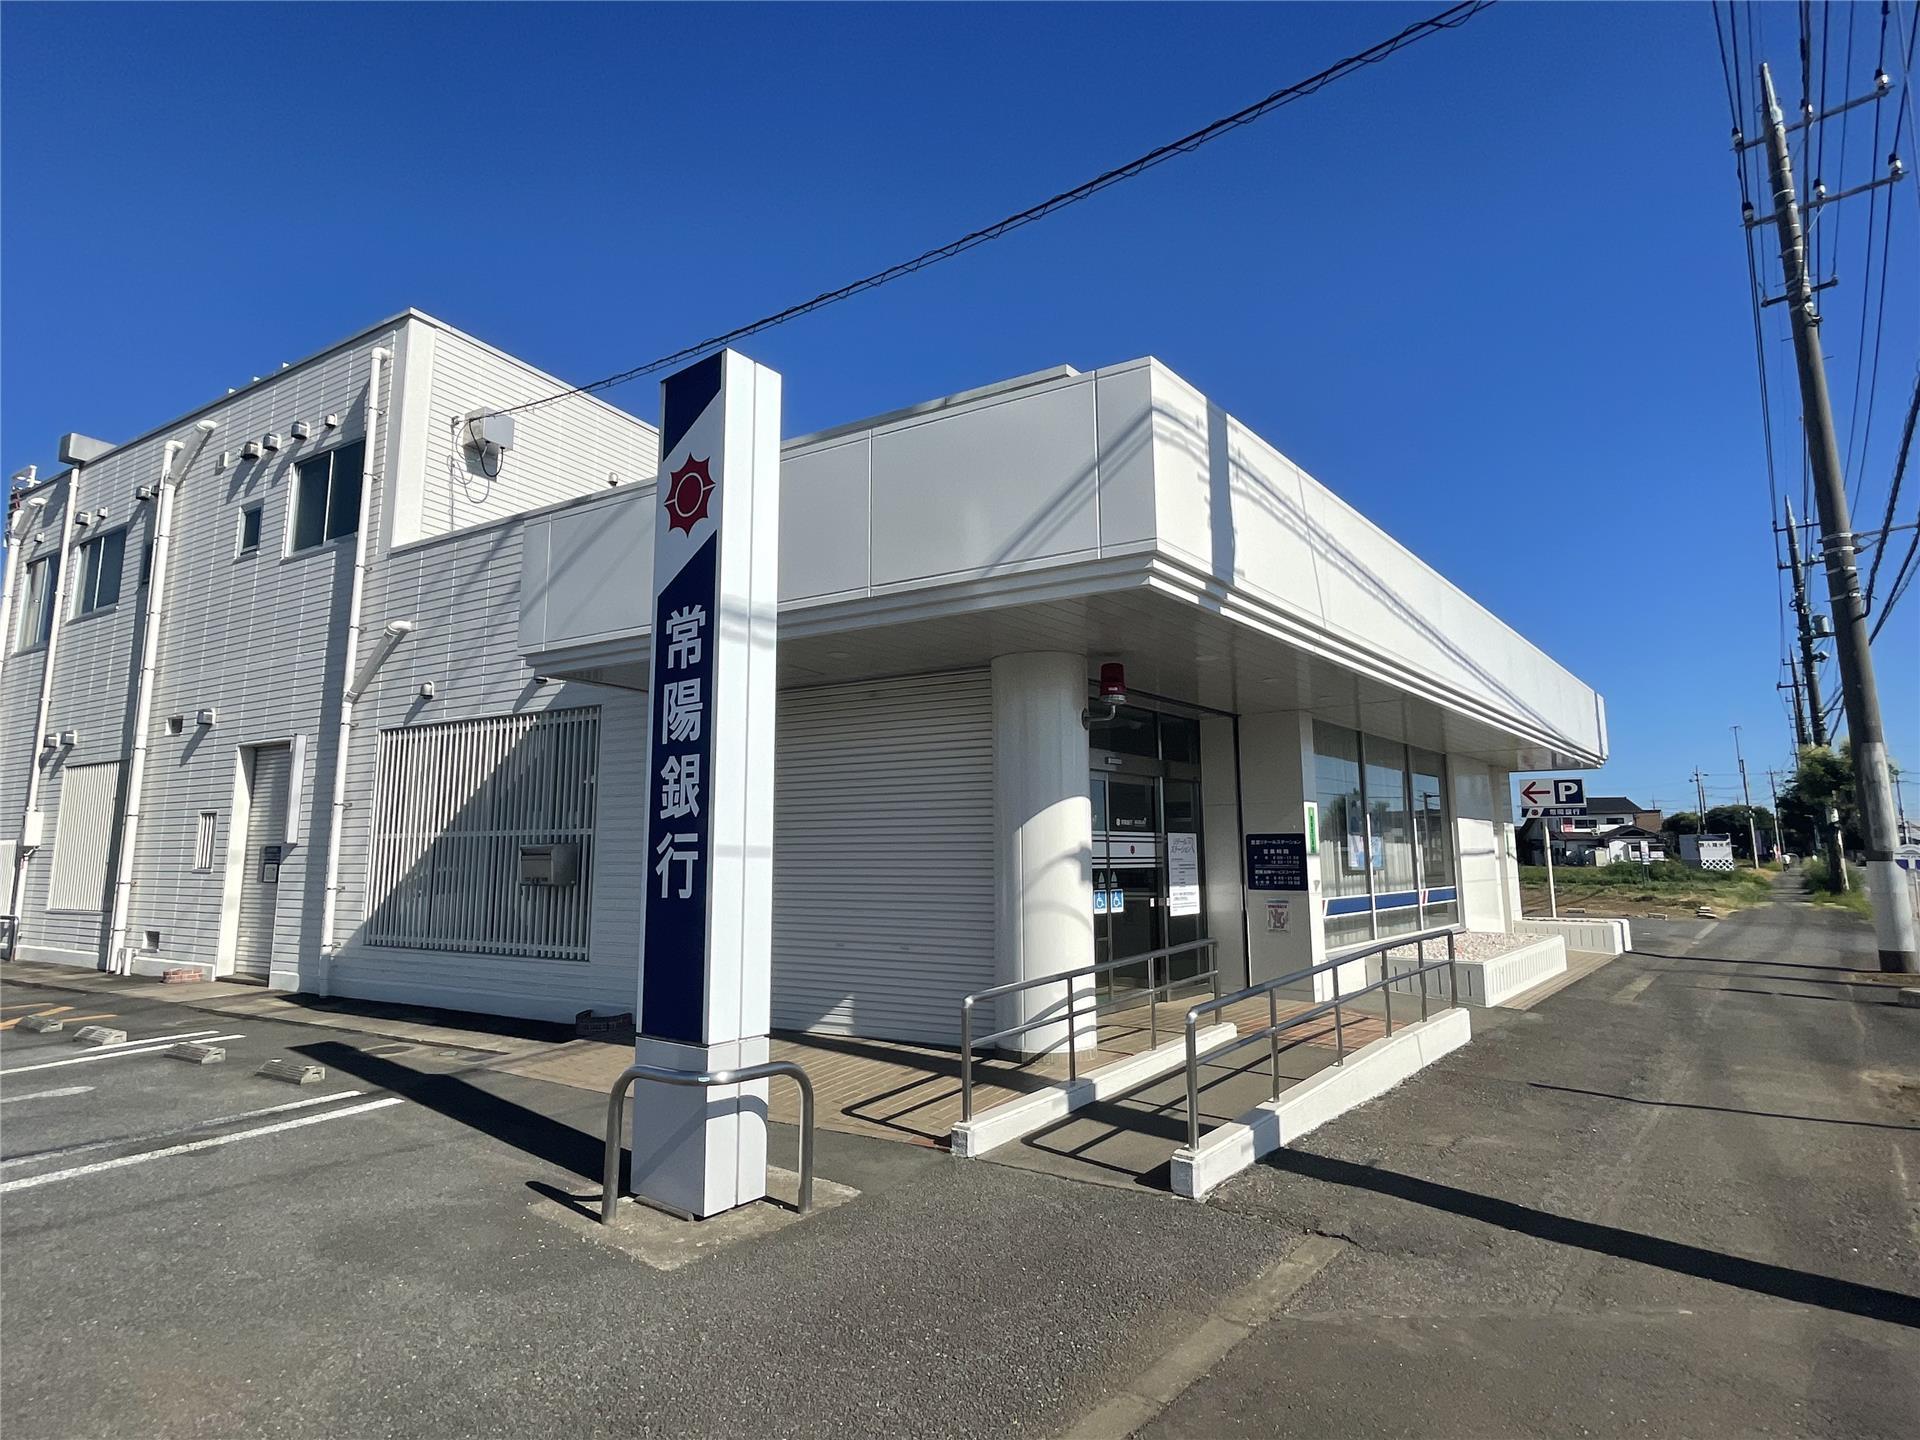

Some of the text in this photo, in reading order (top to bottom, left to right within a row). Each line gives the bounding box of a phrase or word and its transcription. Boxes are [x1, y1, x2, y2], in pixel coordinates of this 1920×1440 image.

[655, 604, 706, 899] 常陽銀行
[1558, 782, 1578, 802] P
